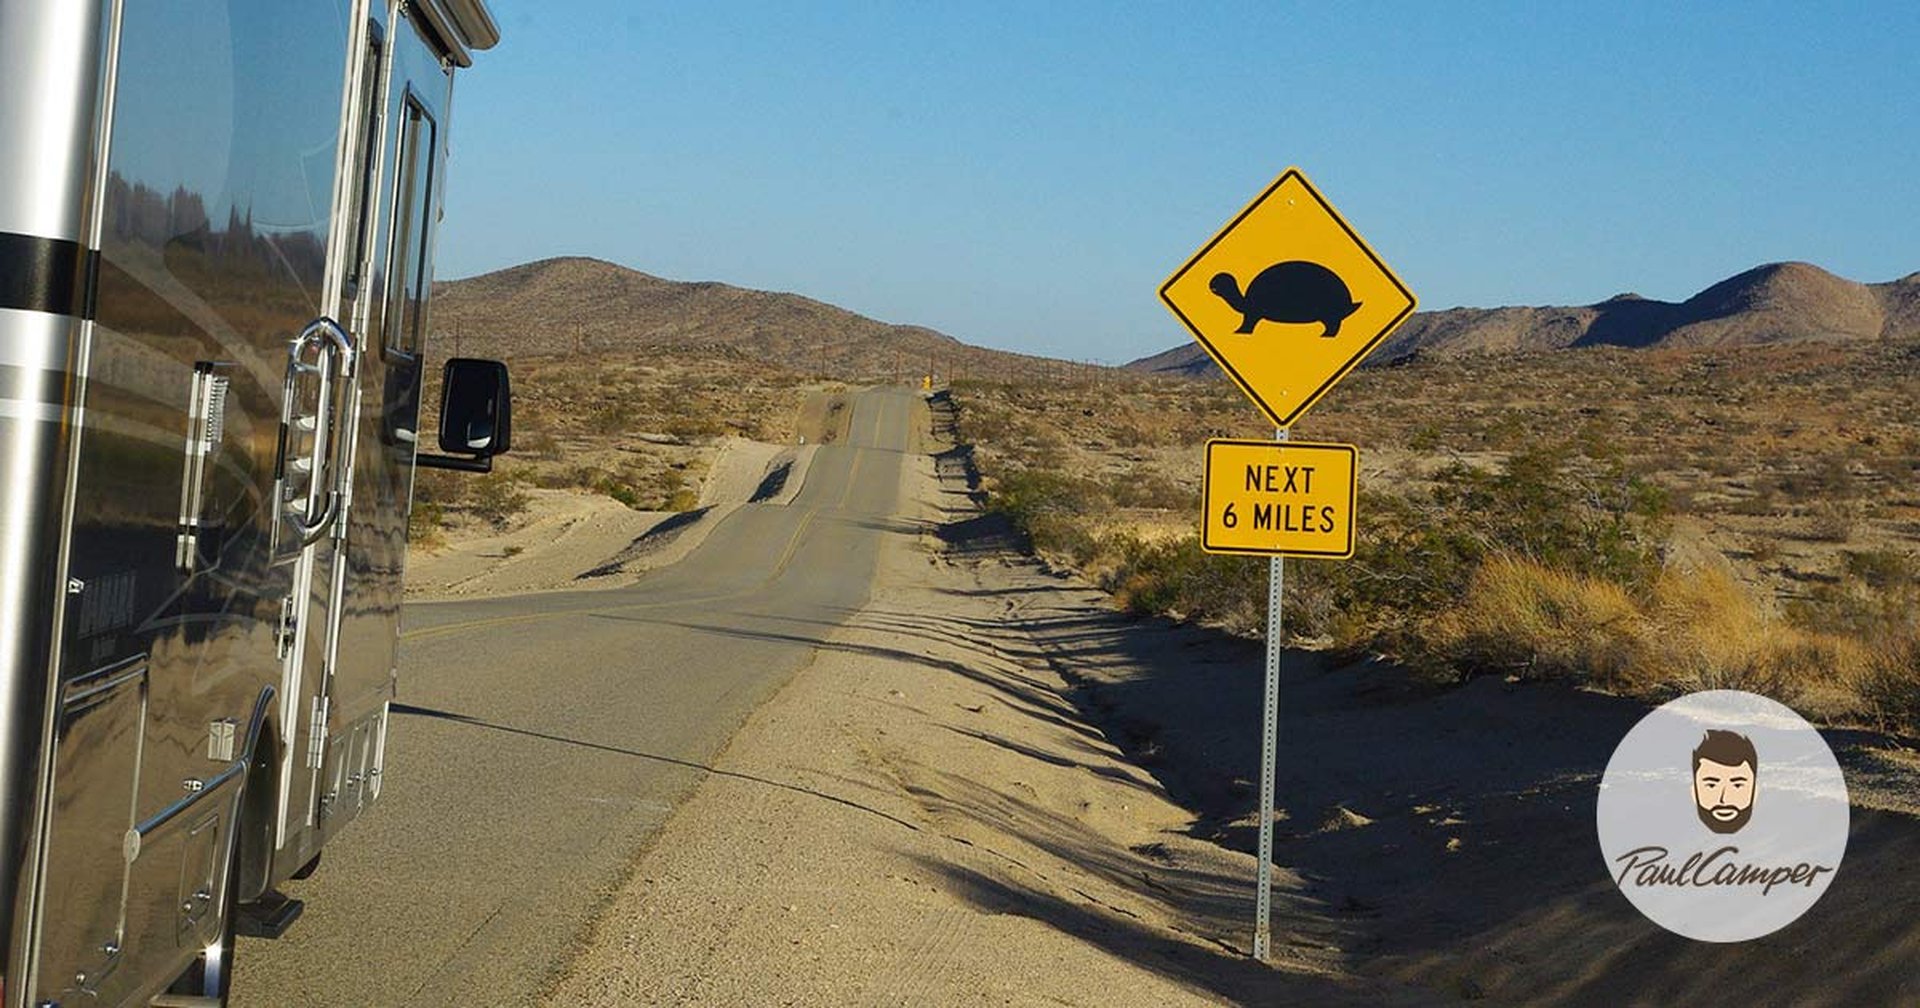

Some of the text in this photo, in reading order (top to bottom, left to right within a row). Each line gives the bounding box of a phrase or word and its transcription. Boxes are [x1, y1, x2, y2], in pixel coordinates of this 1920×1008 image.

[1245, 464, 1315, 494] NEXT
[1222, 502, 1335, 534] 6 MILES
